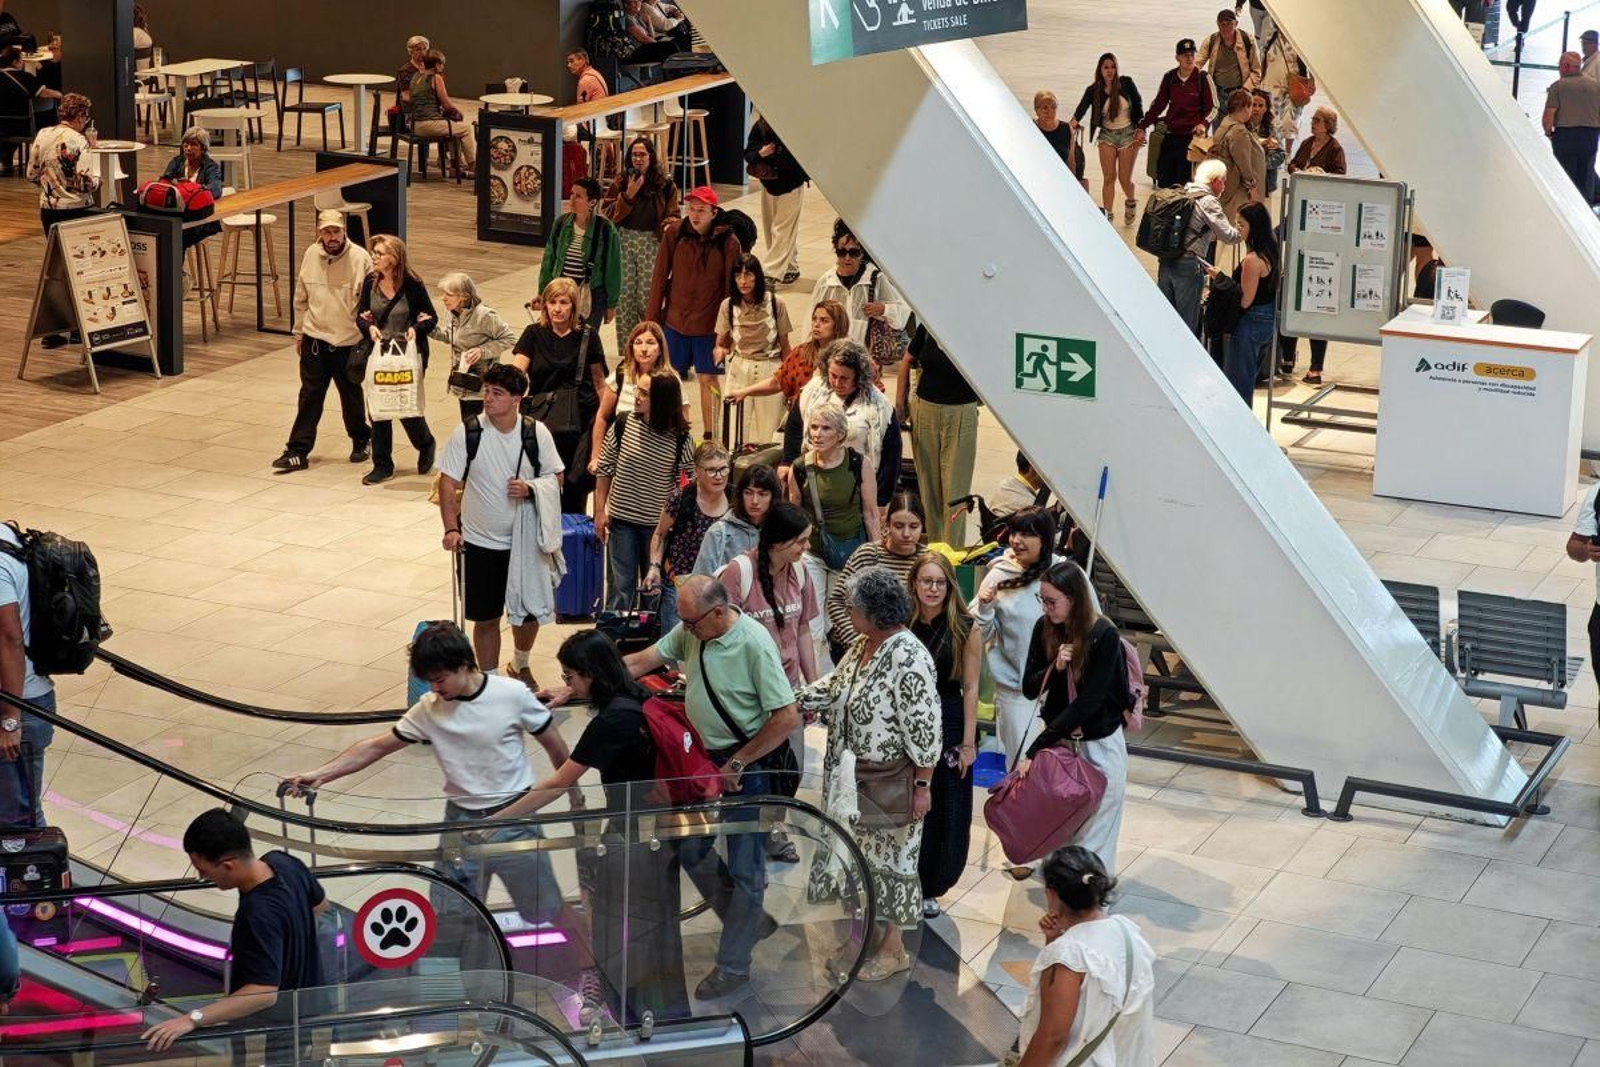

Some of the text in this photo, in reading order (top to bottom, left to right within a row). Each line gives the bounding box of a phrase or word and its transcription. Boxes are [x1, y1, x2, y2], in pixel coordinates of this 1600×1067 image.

[922, 14, 968, 31] TICKETS SALE
[1434, 361, 1525, 378] adif acerca
